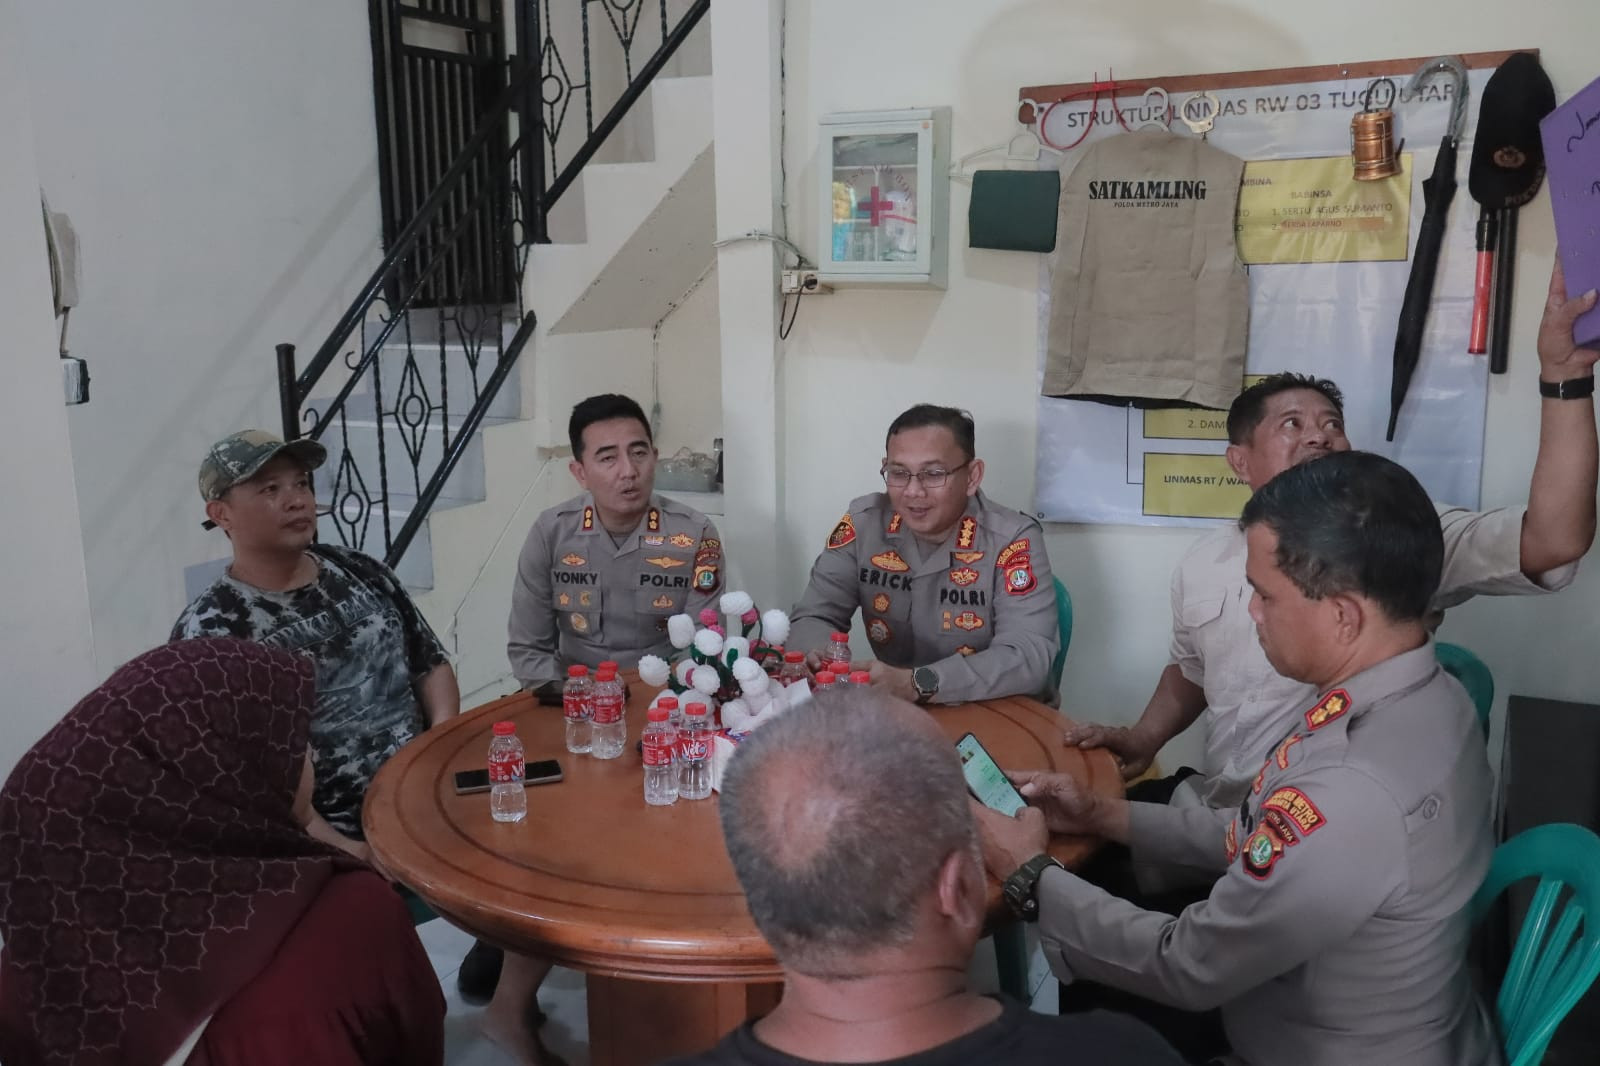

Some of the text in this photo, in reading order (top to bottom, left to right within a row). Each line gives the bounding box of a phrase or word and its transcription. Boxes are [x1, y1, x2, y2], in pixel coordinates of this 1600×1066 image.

[1173, 99, 1247, 120] LNMAS
[1256, 96, 1288, 114] RW
[1296, 94, 1320, 110] 03
[1088, 180, 1207, 200] SATKAMLING
[1200, 419, 1226, 430] DAM
[1164, 474, 1201, 484] LINMAS
[1204, 476, 1216, 485] RT
[1226, 477, 1249, 486] WA
[554, 571, 598, 585] YONKY
[640, 574, 689, 588] POLRI
[860, 568, 912, 591] ERICK
[940, 588, 986, 606] POLRI
